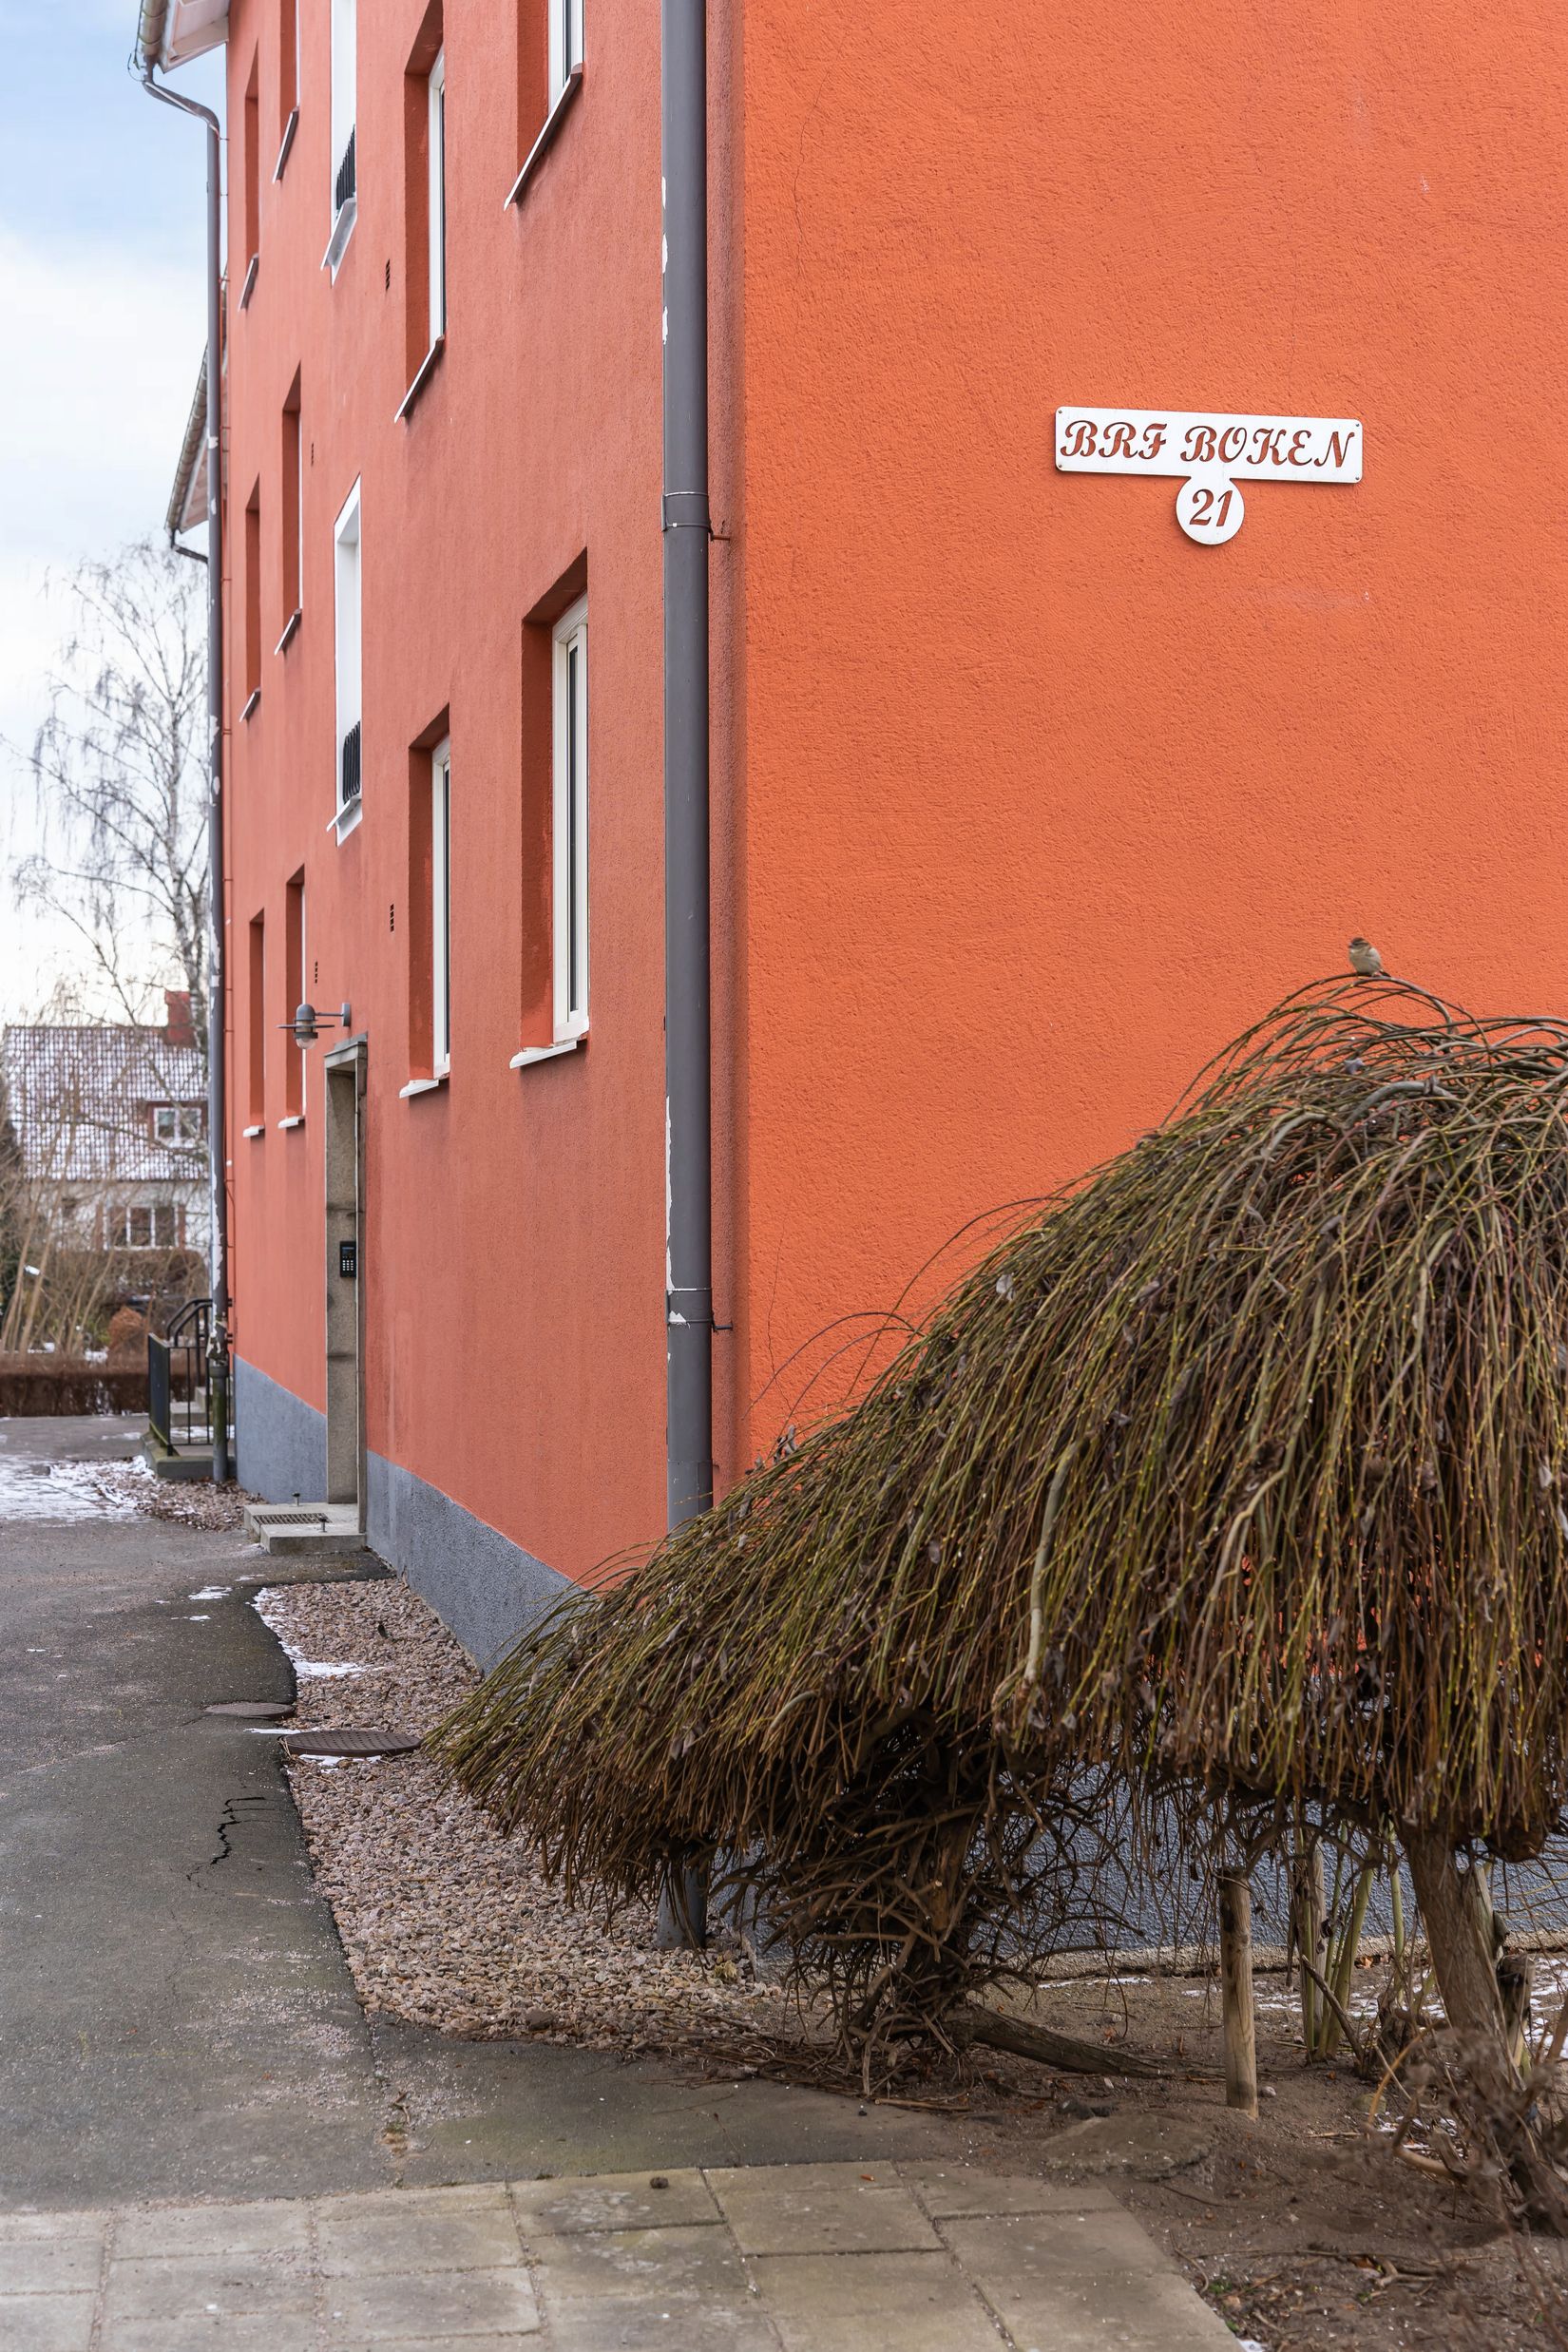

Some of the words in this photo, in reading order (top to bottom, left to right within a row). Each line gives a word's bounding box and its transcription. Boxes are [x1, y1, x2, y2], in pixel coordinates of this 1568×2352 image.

[1060, 420, 1168, 460] BRF
[1179, 425, 1356, 468] BOKEN
[1189, 489, 1233, 527] 21
